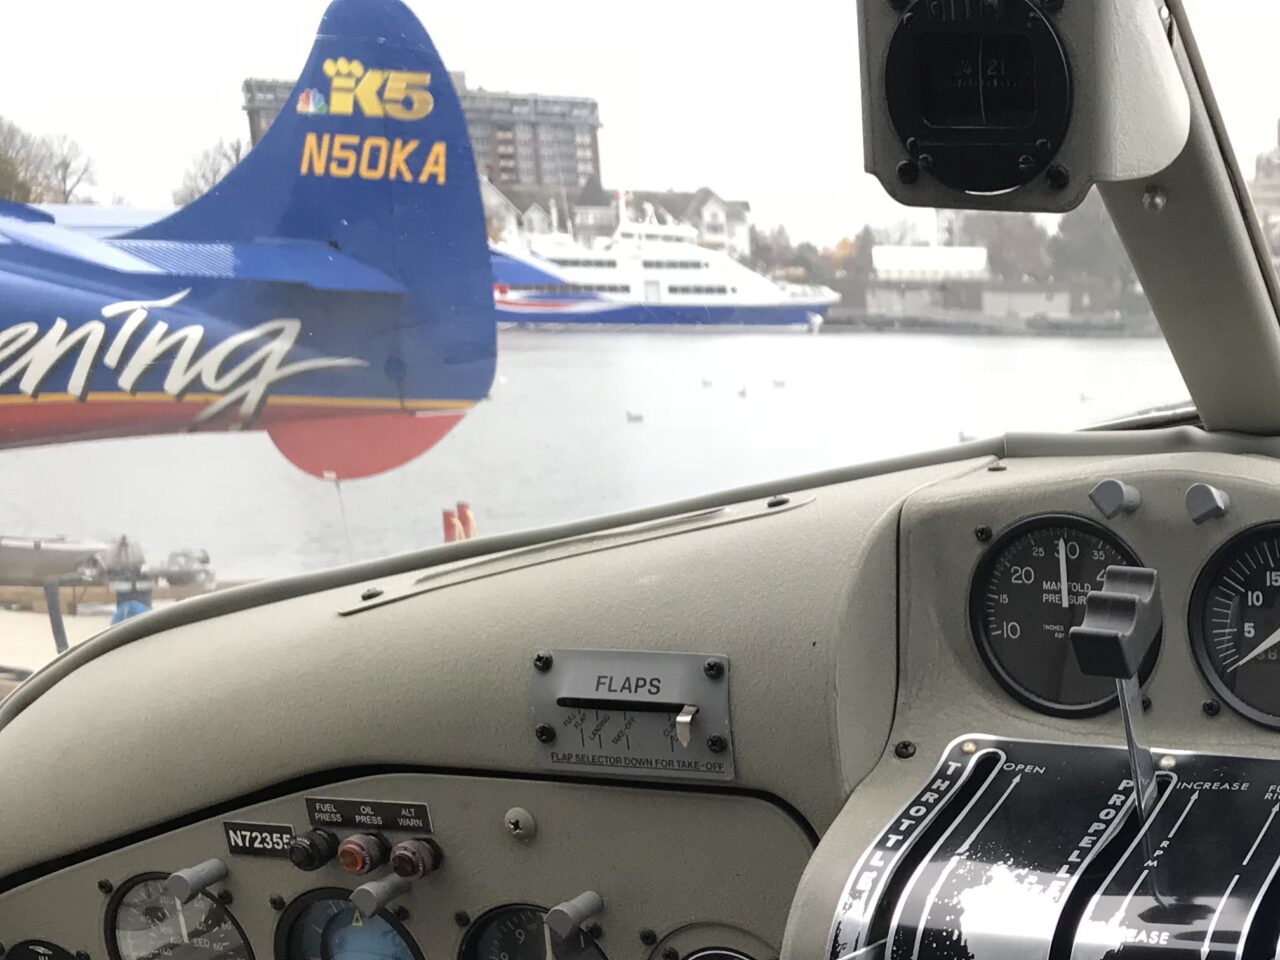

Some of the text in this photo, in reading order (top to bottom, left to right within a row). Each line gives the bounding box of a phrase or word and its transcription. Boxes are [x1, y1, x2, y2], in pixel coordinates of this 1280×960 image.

[301, 133, 447, 185] N50KA
[1010, 567, 1035, 584] 20
[1248, 591, 1263, 607] 10
[1003, 622, 1020, 639] 10
[1244, 624, 1255, 638] 5
[595, 675, 661, 695] FLAPS
[551, 752, 725, 771] FLAP SELECTOR DOWN FOR TAKE-OFF
[1003, 761, 1046, 777] OPEN
[1176, 780, 1250, 793] INCREASE
[316, 803, 337, 813] FUEL
[360, 806, 375, 815] OIL
[401, 808, 416, 817] ALT
[315, 812, 342, 823] PRESS
[355, 815, 383, 825] PRESS
[398, 817, 423, 828] WARN
